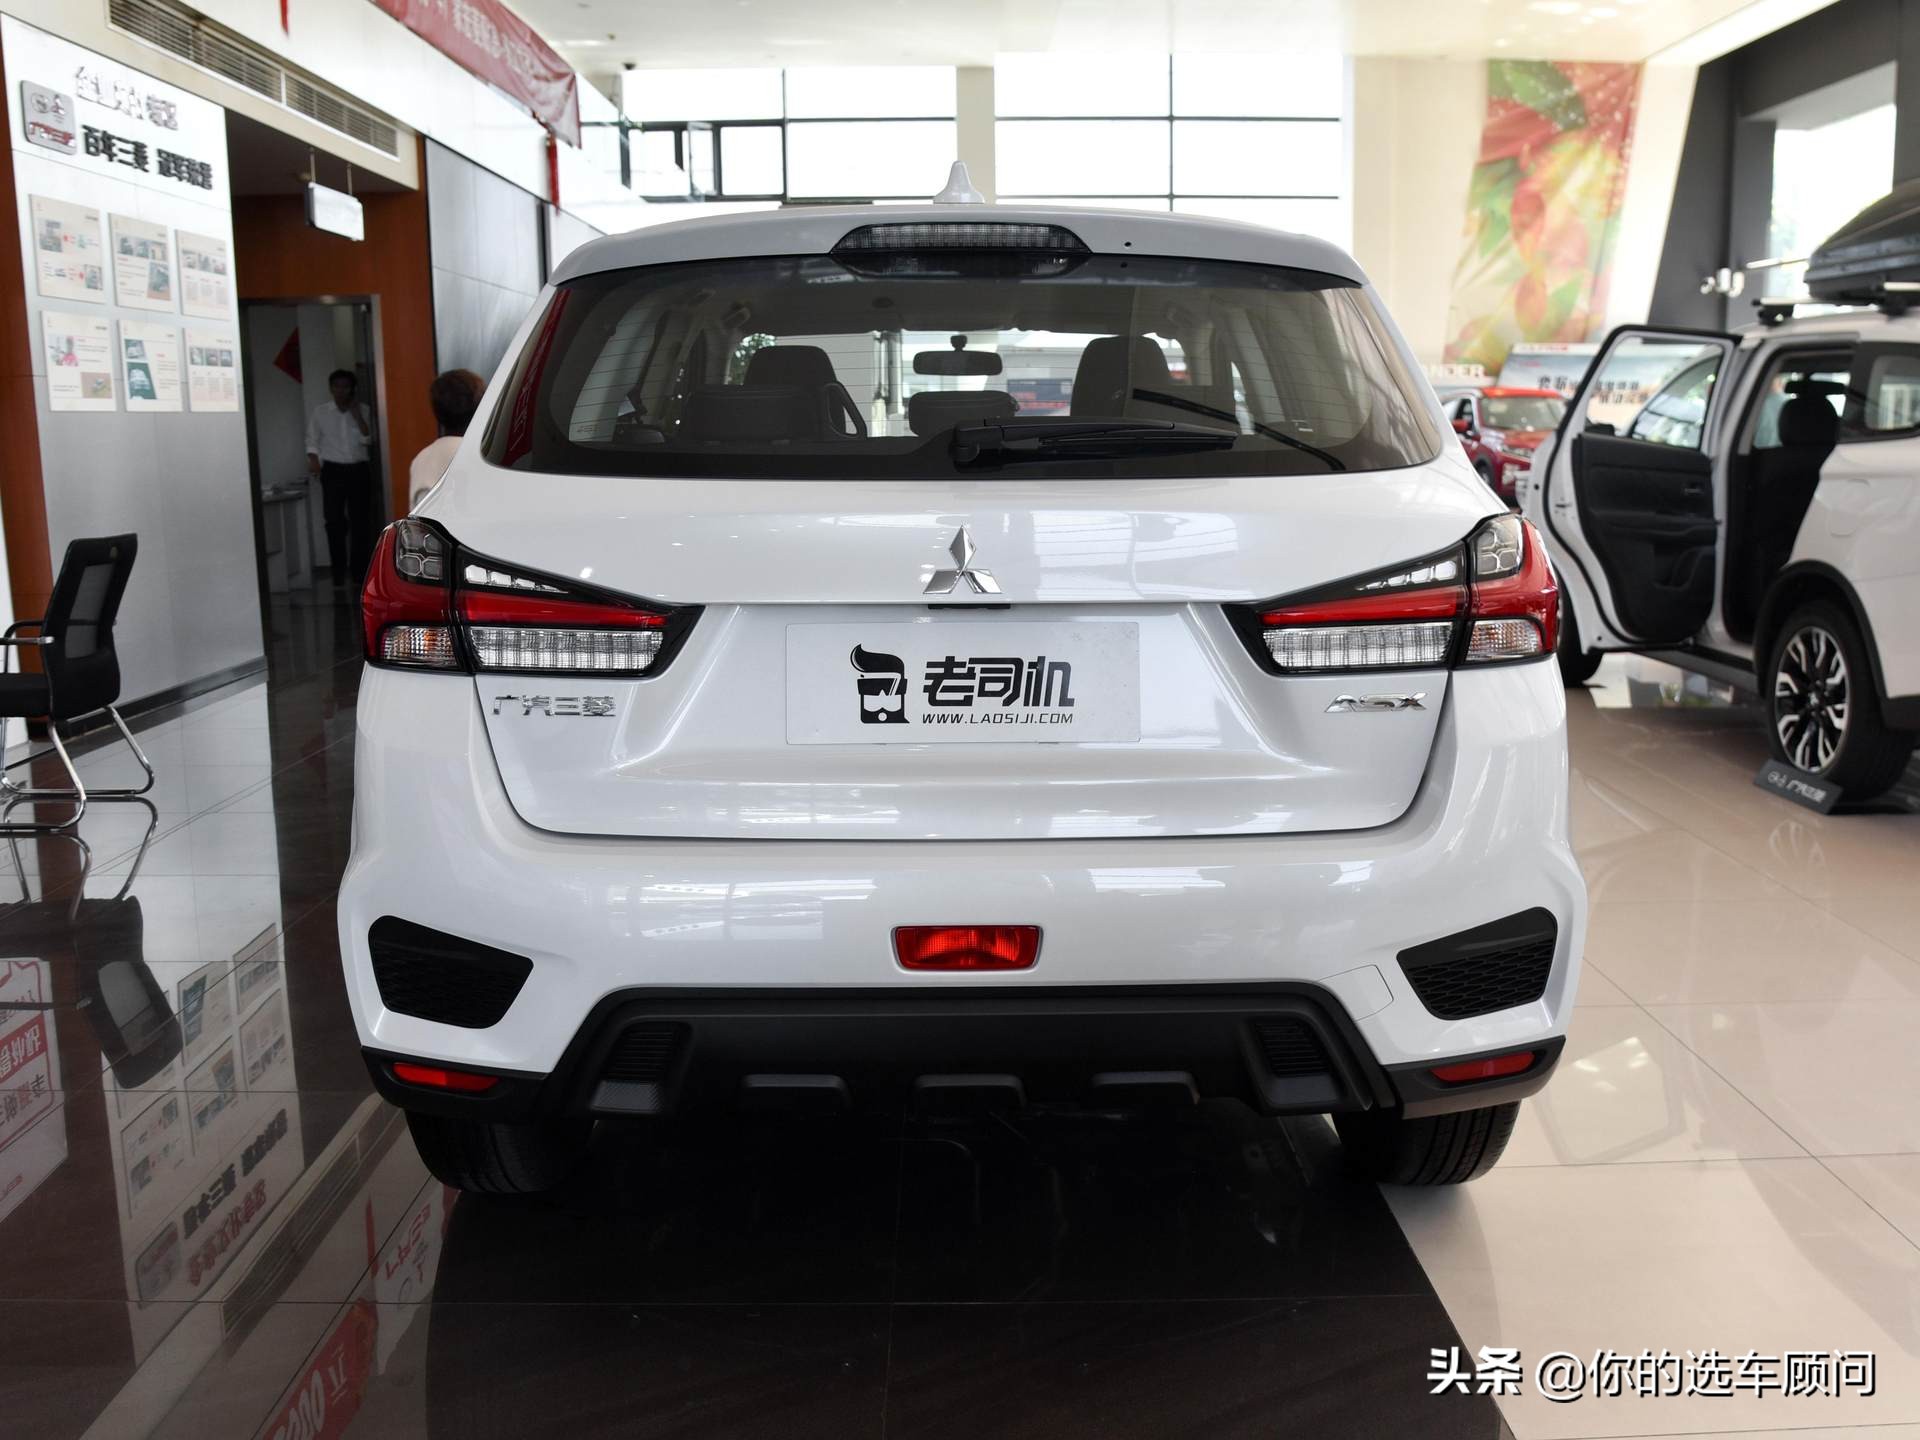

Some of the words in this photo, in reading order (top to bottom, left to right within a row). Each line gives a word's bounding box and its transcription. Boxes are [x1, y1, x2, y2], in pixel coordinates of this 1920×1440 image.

[922, 655, 1075, 707] 老司机
[493, 695, 616, 717] 广汽三菱
[1323, 692, 1428, 713] ASX
[922, 712, 1074, 725] WWW.LAOSIJI.COM
